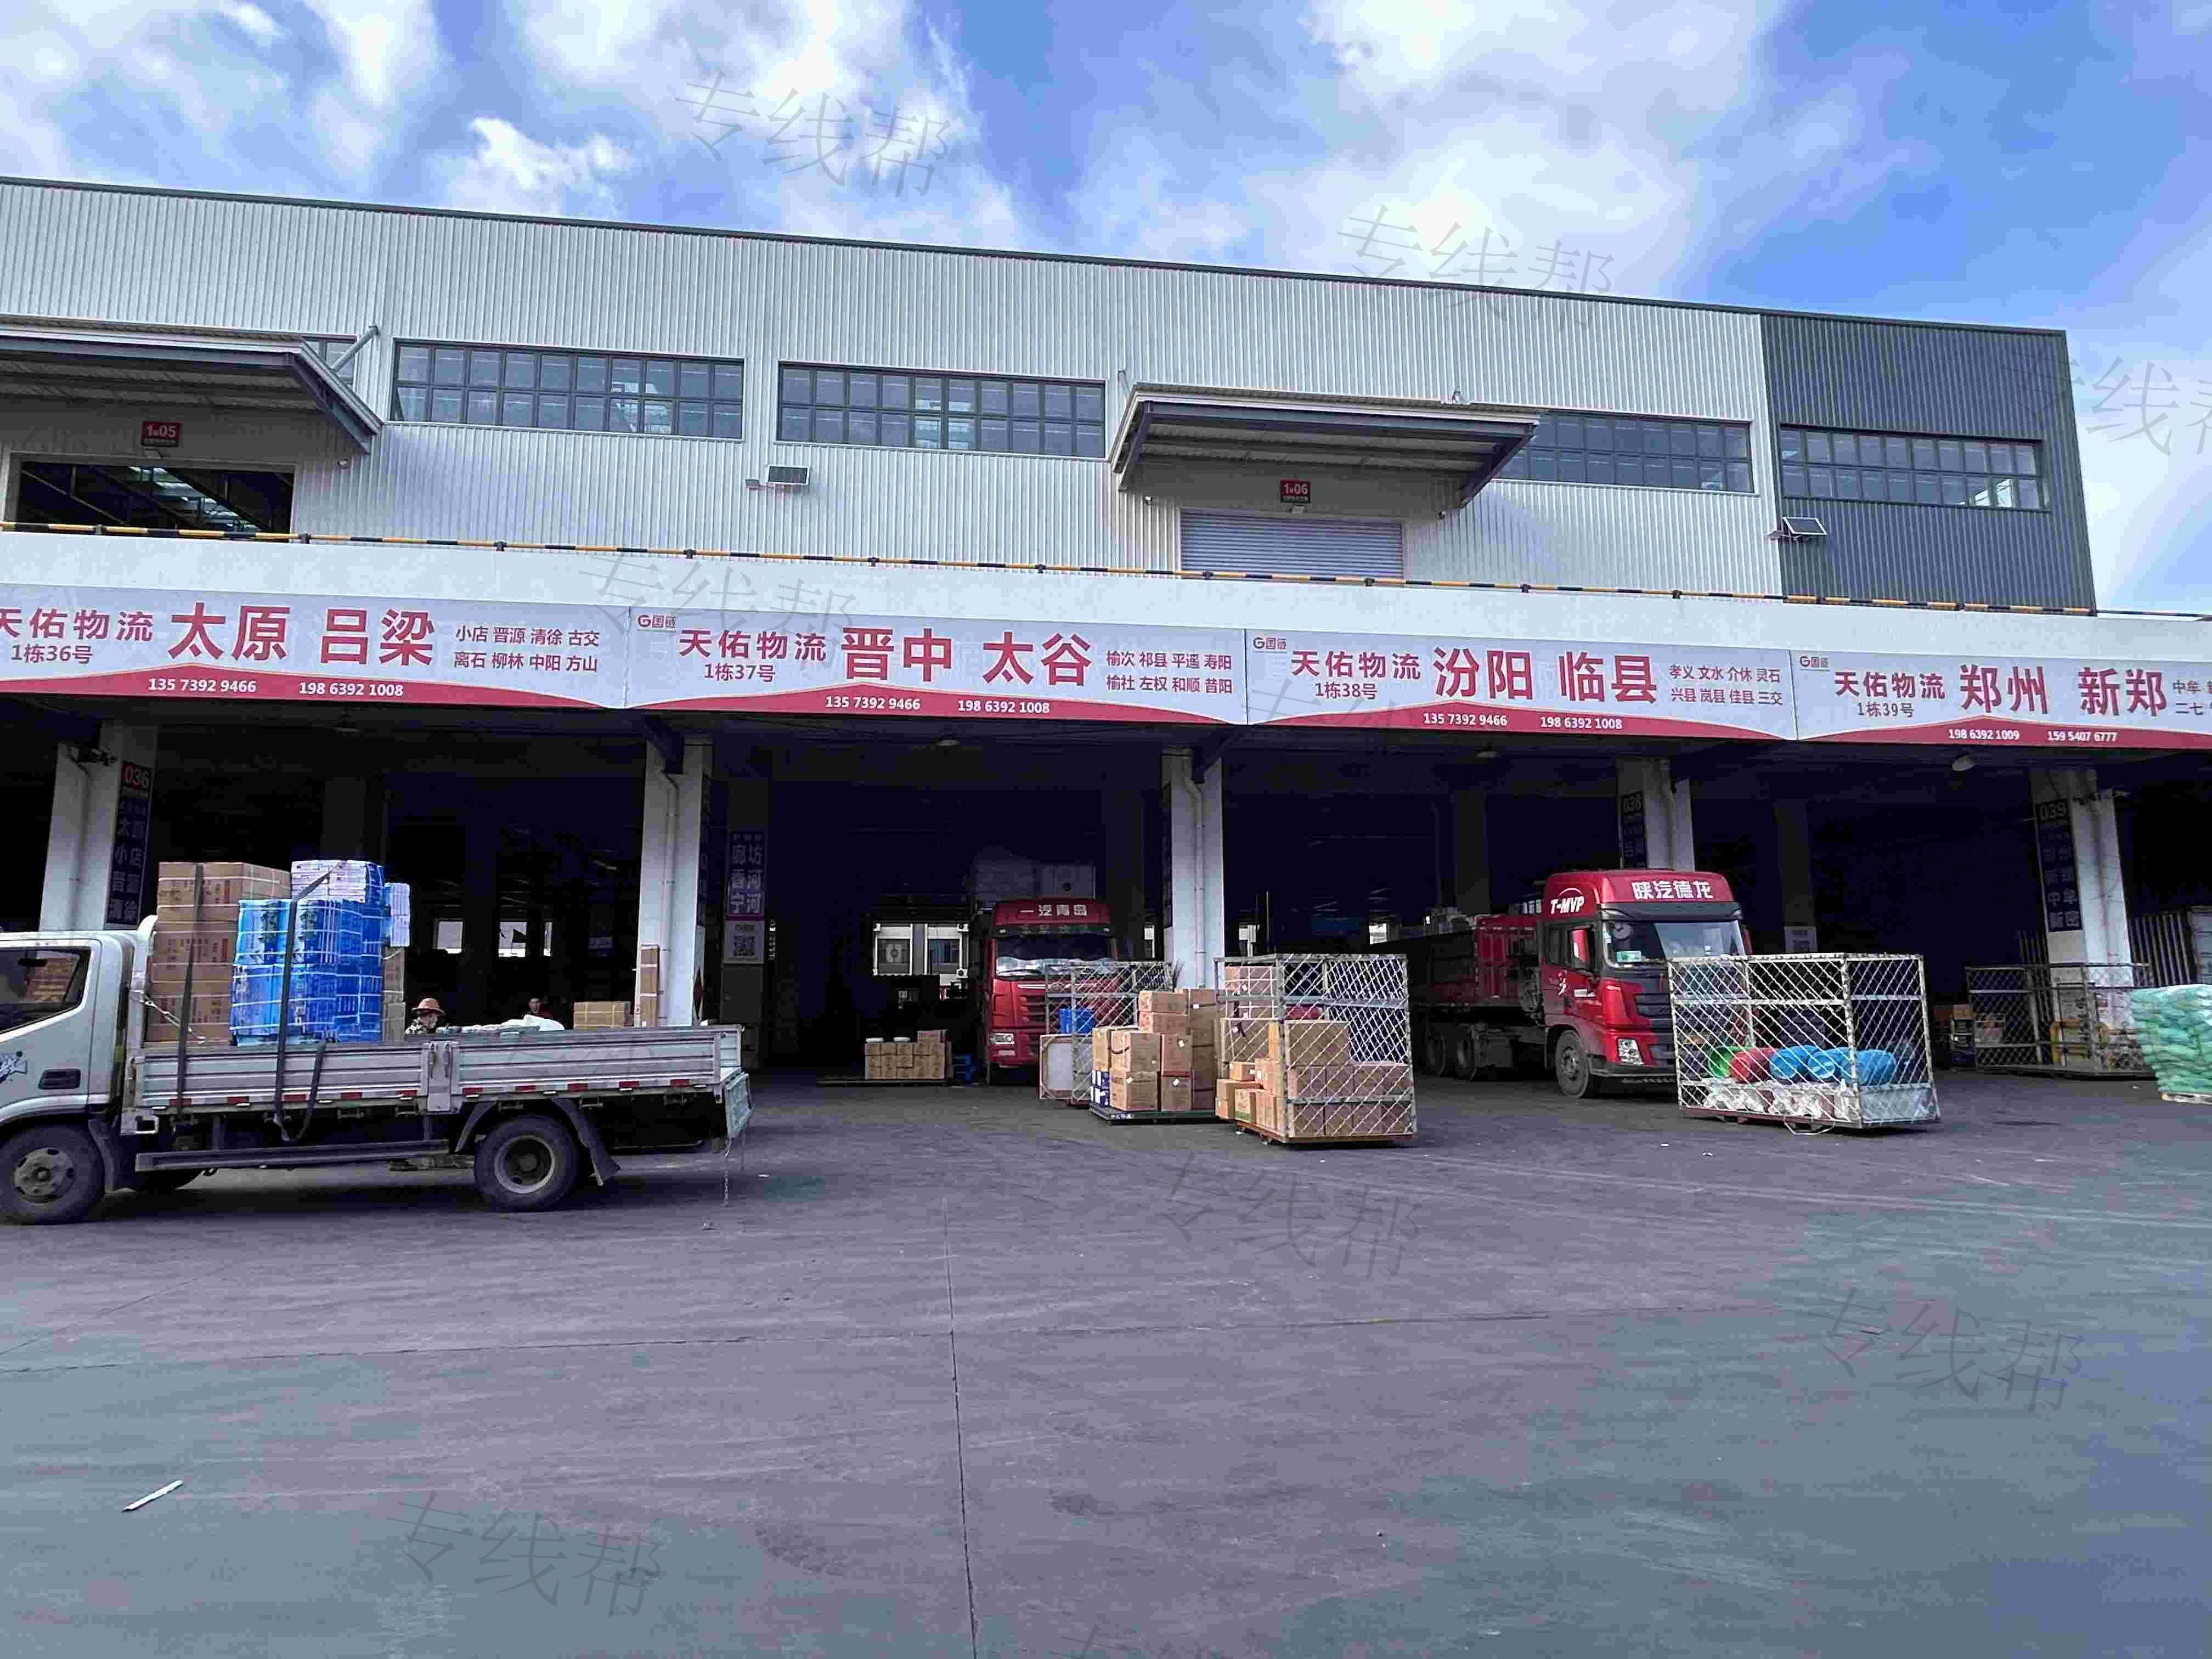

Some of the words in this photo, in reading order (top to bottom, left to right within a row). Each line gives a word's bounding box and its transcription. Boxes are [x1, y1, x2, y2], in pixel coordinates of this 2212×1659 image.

[167, 602, 290, 660] 太原
[320, 608, 435, 666] 吕梁
[455, 625, 489, 642] 小店
[493, 627, 526, 644] 晋源
[531, 628, 563, 646] 清徐
[568, 629, 600, 647] 古交
[11, 644, 93, 664] 1栋36号
[679, 629, 826, 662] 天佑物流
[454, 651, 487, 669] 离石
[491, 652, 524, 669] 柳林
[529, 653, 561, 672] 中阳
[566, 655, 597, 672] 方山
[840, 627, 952, 682] 晋中
[982, 631, 1092, 687] 太谷
[1106, 650, 1135, 667] 榆次
[1139, 652, 1168, 668] 祁县
[1171, 653, 1200, 669] 平遥
[1204, 654, 1232, 670] 寿阳
[1291, 651, 1421, 680] 天佑物流
[704, 662, 776, 682] 1栋37号
[1433, 647, 1533, 700] 汾阳
[1559, 651, 1657, 704] 临县
[1669, 664, 1695, 680] 孝义
[1697, 665, 1724, 681] 文水
[1726, 666, 1753, 682] 介休
[1756, 668, 1781, 684] 灵石
[149, 678, 176, 691] 135
[180, 679, 216, 692] 7392
[220, 680, 256, 692] 9466
[299, 682, 326, 695] 198
[329, 682, 365, 696] 6392
[368, 684, 404, 697] 1008
[1106, 674, 1136, 691] 榆社
[1139, 675, 1168, 691] 左权
[1172, 677, 1200, 693] 和顺
[1205, 678, 1232, 694] 昔阳
[1315, 681, 1378, 700] 1栋38号
[1834, 672, 1945, 699] 天佑物流
[1960, 664, 2049, 714] 郑州
[2078, 667, 2167, 717] 新郑
[826, 696, 849, 708] 135
[853, 697, 885, 709] 7392
[888, 698, 921, 710] 9466
[1671, 687, 1697, 703] 兴县
[1700, 689, 1725, 703] 岚县
[1758, 691, 1784, 706] 三交
[958, 700, 981, 712] 198
[985, 701, 1015, 713] 6392
[1019, 702, 1050, 714] 1008
[1857, 701, 1914, 718] 1栋39号
[2175, 702, 2204, 716] 二七
[1423, 713, 1445, 724] 135
[1447, 713, 1476, 725] 7392
[1479, 714, 1508, 726] 9466
[1540, 716, 1561, 727] 198
[1564, 717, 1592, 729] 6392
[1594, 718, 1622, 730] 1008
[1948, 729, 1967, 739] 198
[1969, 729, 1994, 740] 6392
[1995, 730, 2020, 740] 1009
[1550, 896, 1584, 915] T-MVP
